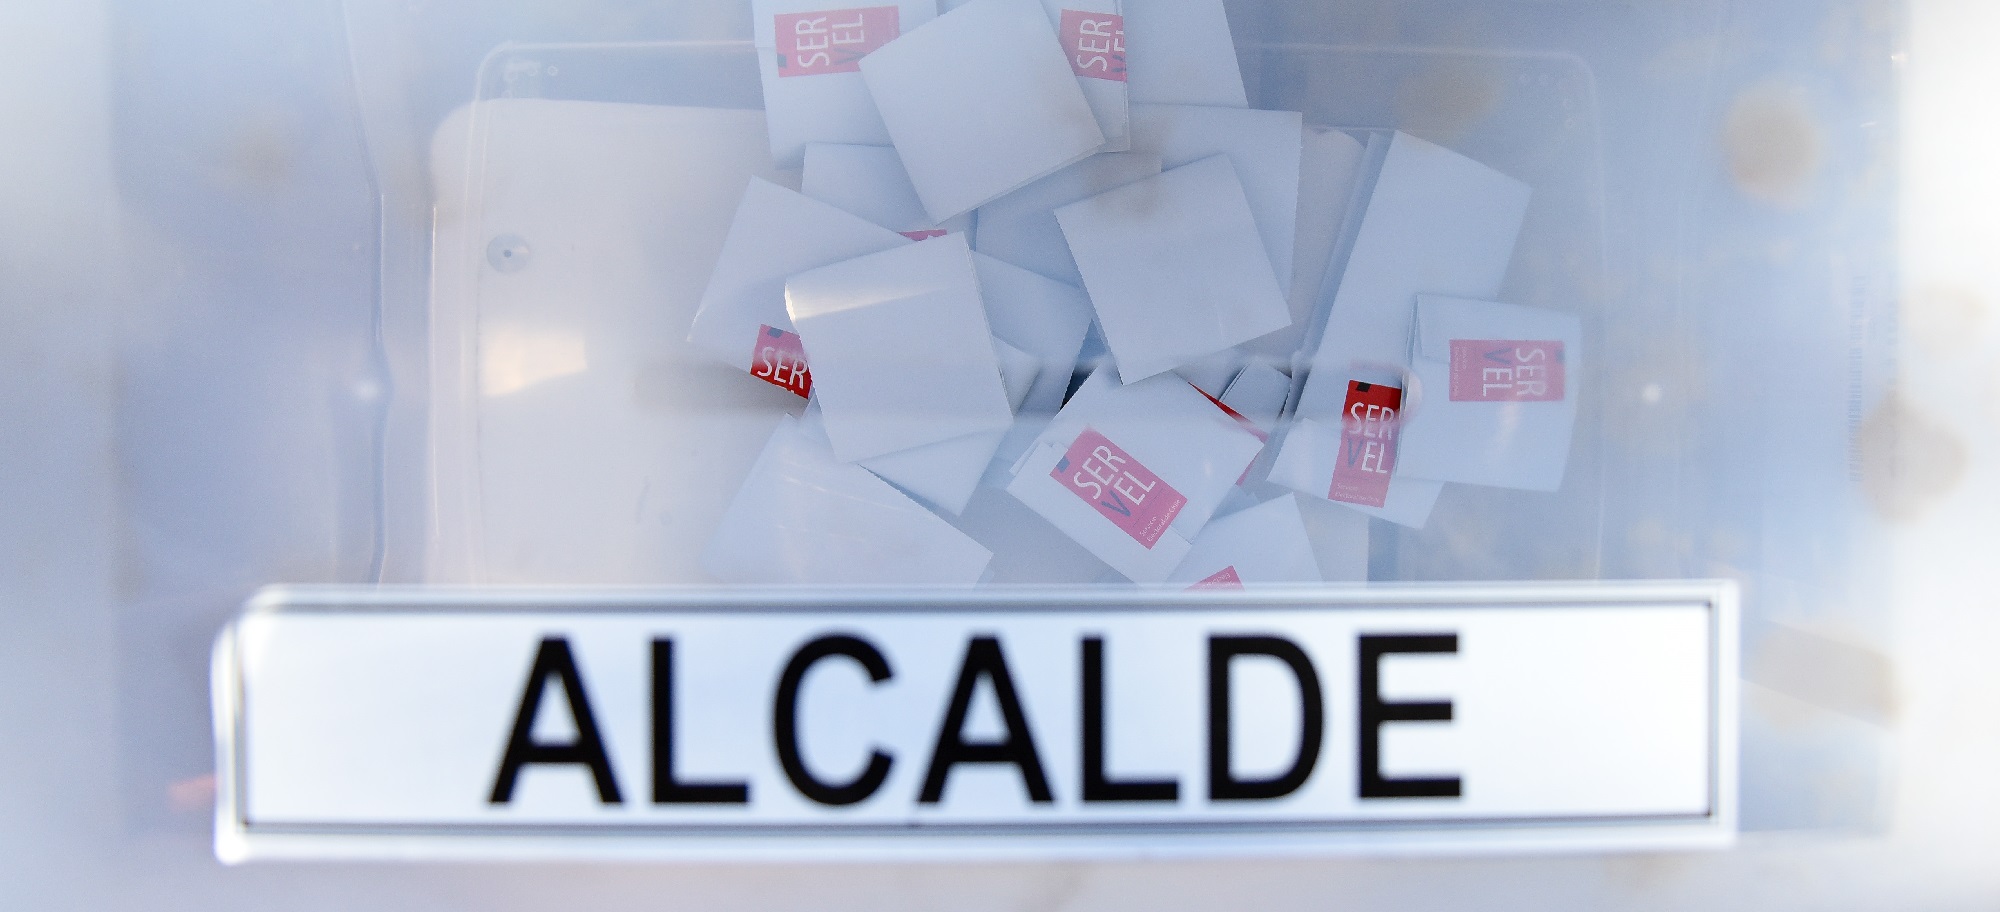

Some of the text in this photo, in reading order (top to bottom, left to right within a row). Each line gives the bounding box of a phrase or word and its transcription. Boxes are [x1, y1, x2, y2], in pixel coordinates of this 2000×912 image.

[795, 17, 830, 68] SER
[832, 12, 866, 66] VEL
[1076, 19, 1112, 72] SER
[757, 346, 807, 389] SER
[1482, 347, 1512, 397] VEL
[1515, 347, 1546, 397] SER
[1348, 402, 1396, 441] SER
[1073, 445, 1126, 500] SER
[1347, 438, 1388, 474] VEL
[1101, 470, 1156, 516] VEL
[489, 632, 1462, 807] ALCALDE
